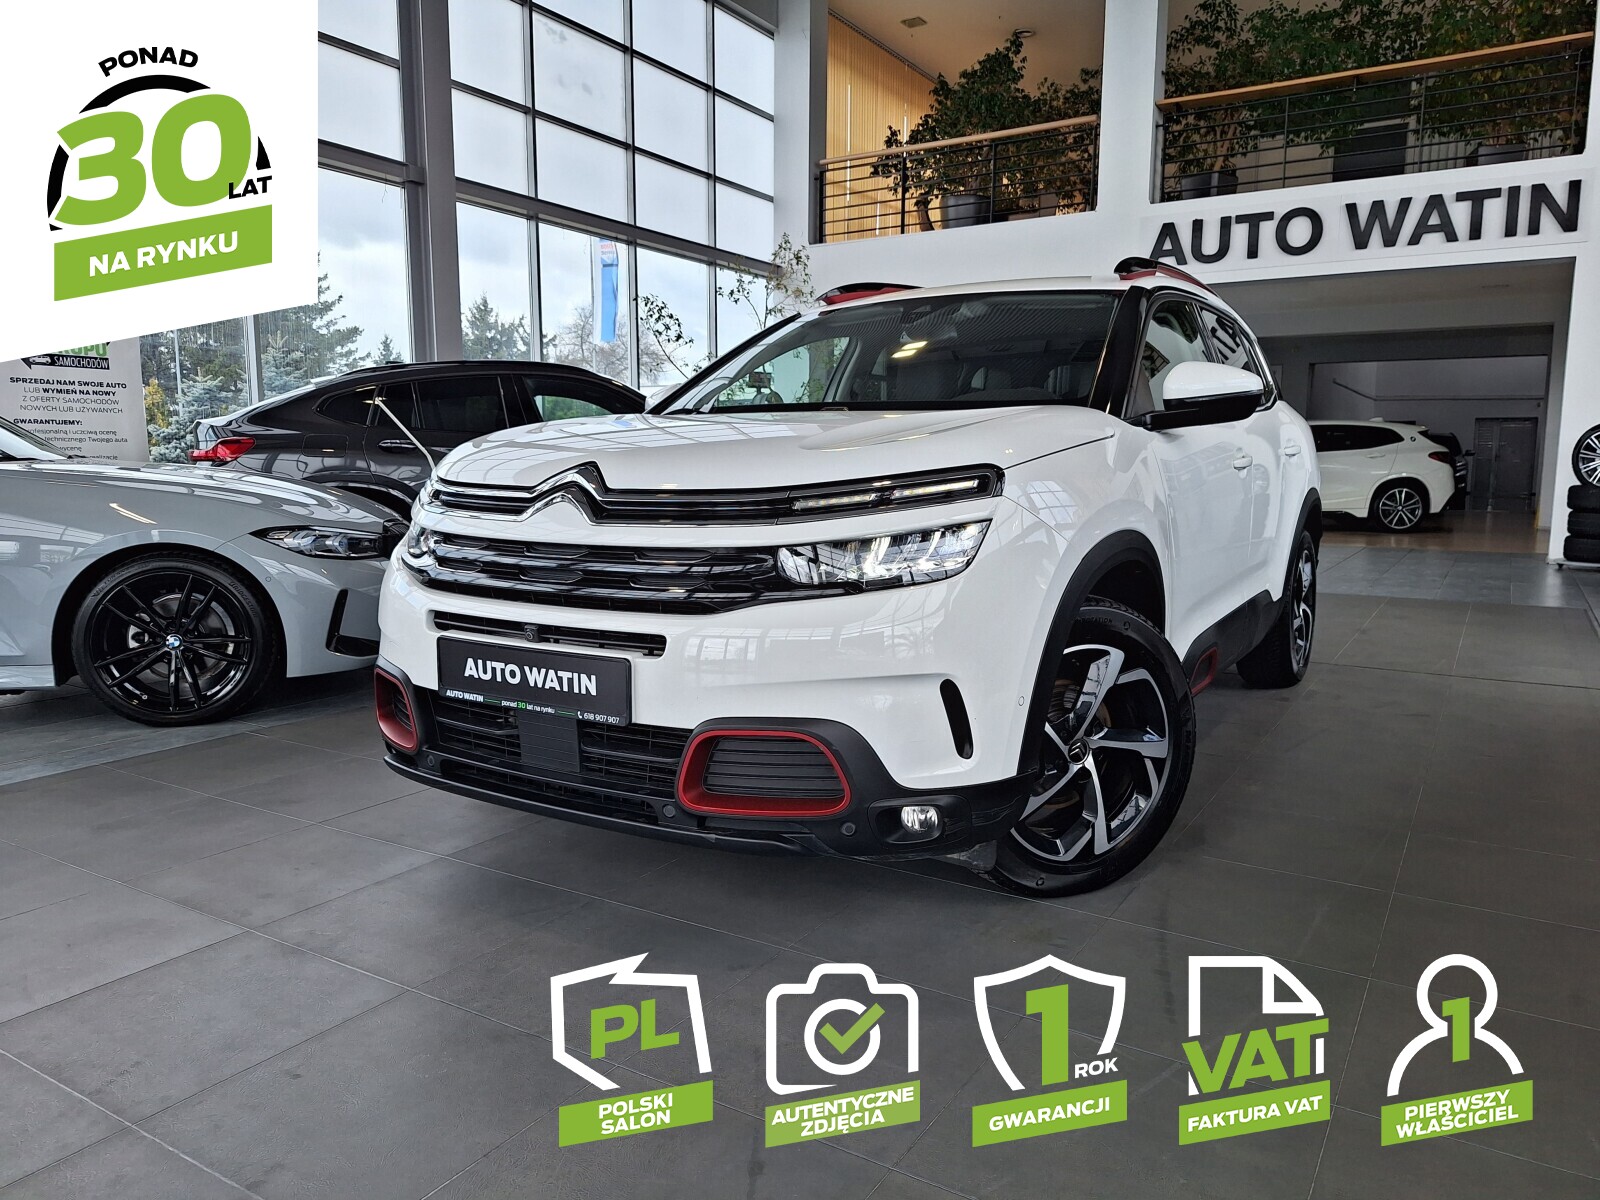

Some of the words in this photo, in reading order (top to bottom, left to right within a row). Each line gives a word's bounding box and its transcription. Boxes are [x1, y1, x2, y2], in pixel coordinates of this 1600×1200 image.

[1150, 206, 1324, 267] AUTO
[1345, 179, 1583, 251] WATIN
[54, 356, 109, 369] SAMOCHODÓW
[9, 376, 55, 385] SPRZEDAJ
[77, 380, 104, 388] SWOJE
[42, 387, 77, 395] WYMIEŃ
[30, 395, 61, 403] OFERTY
[62, 397, 120, 406] SAMOCHODÓW
[20, 404, 58, 412] NOWYCH
[58, 405, 74, 413] LUB
[13, 418, 83, 426] GWARANTUJEMY:
[28, 428, 68, 436] ofesjonalną
[464, 657, 521, 684] AUTO
[523, 665, 597, 696] WATIN
[445, 689, 463, 699] AUTO
[463, 692, 484, 703] WATIN
[501, 700, 518, 709] ponad
[517, 701, 526, 709] 30
[526, 702, 534, 710] lat
[540, 704, 556, 714] rynku
[583, 712, 595, 721] 618
[595, 713, 607, 722] 907
[607, 715, 620, 724] 907
